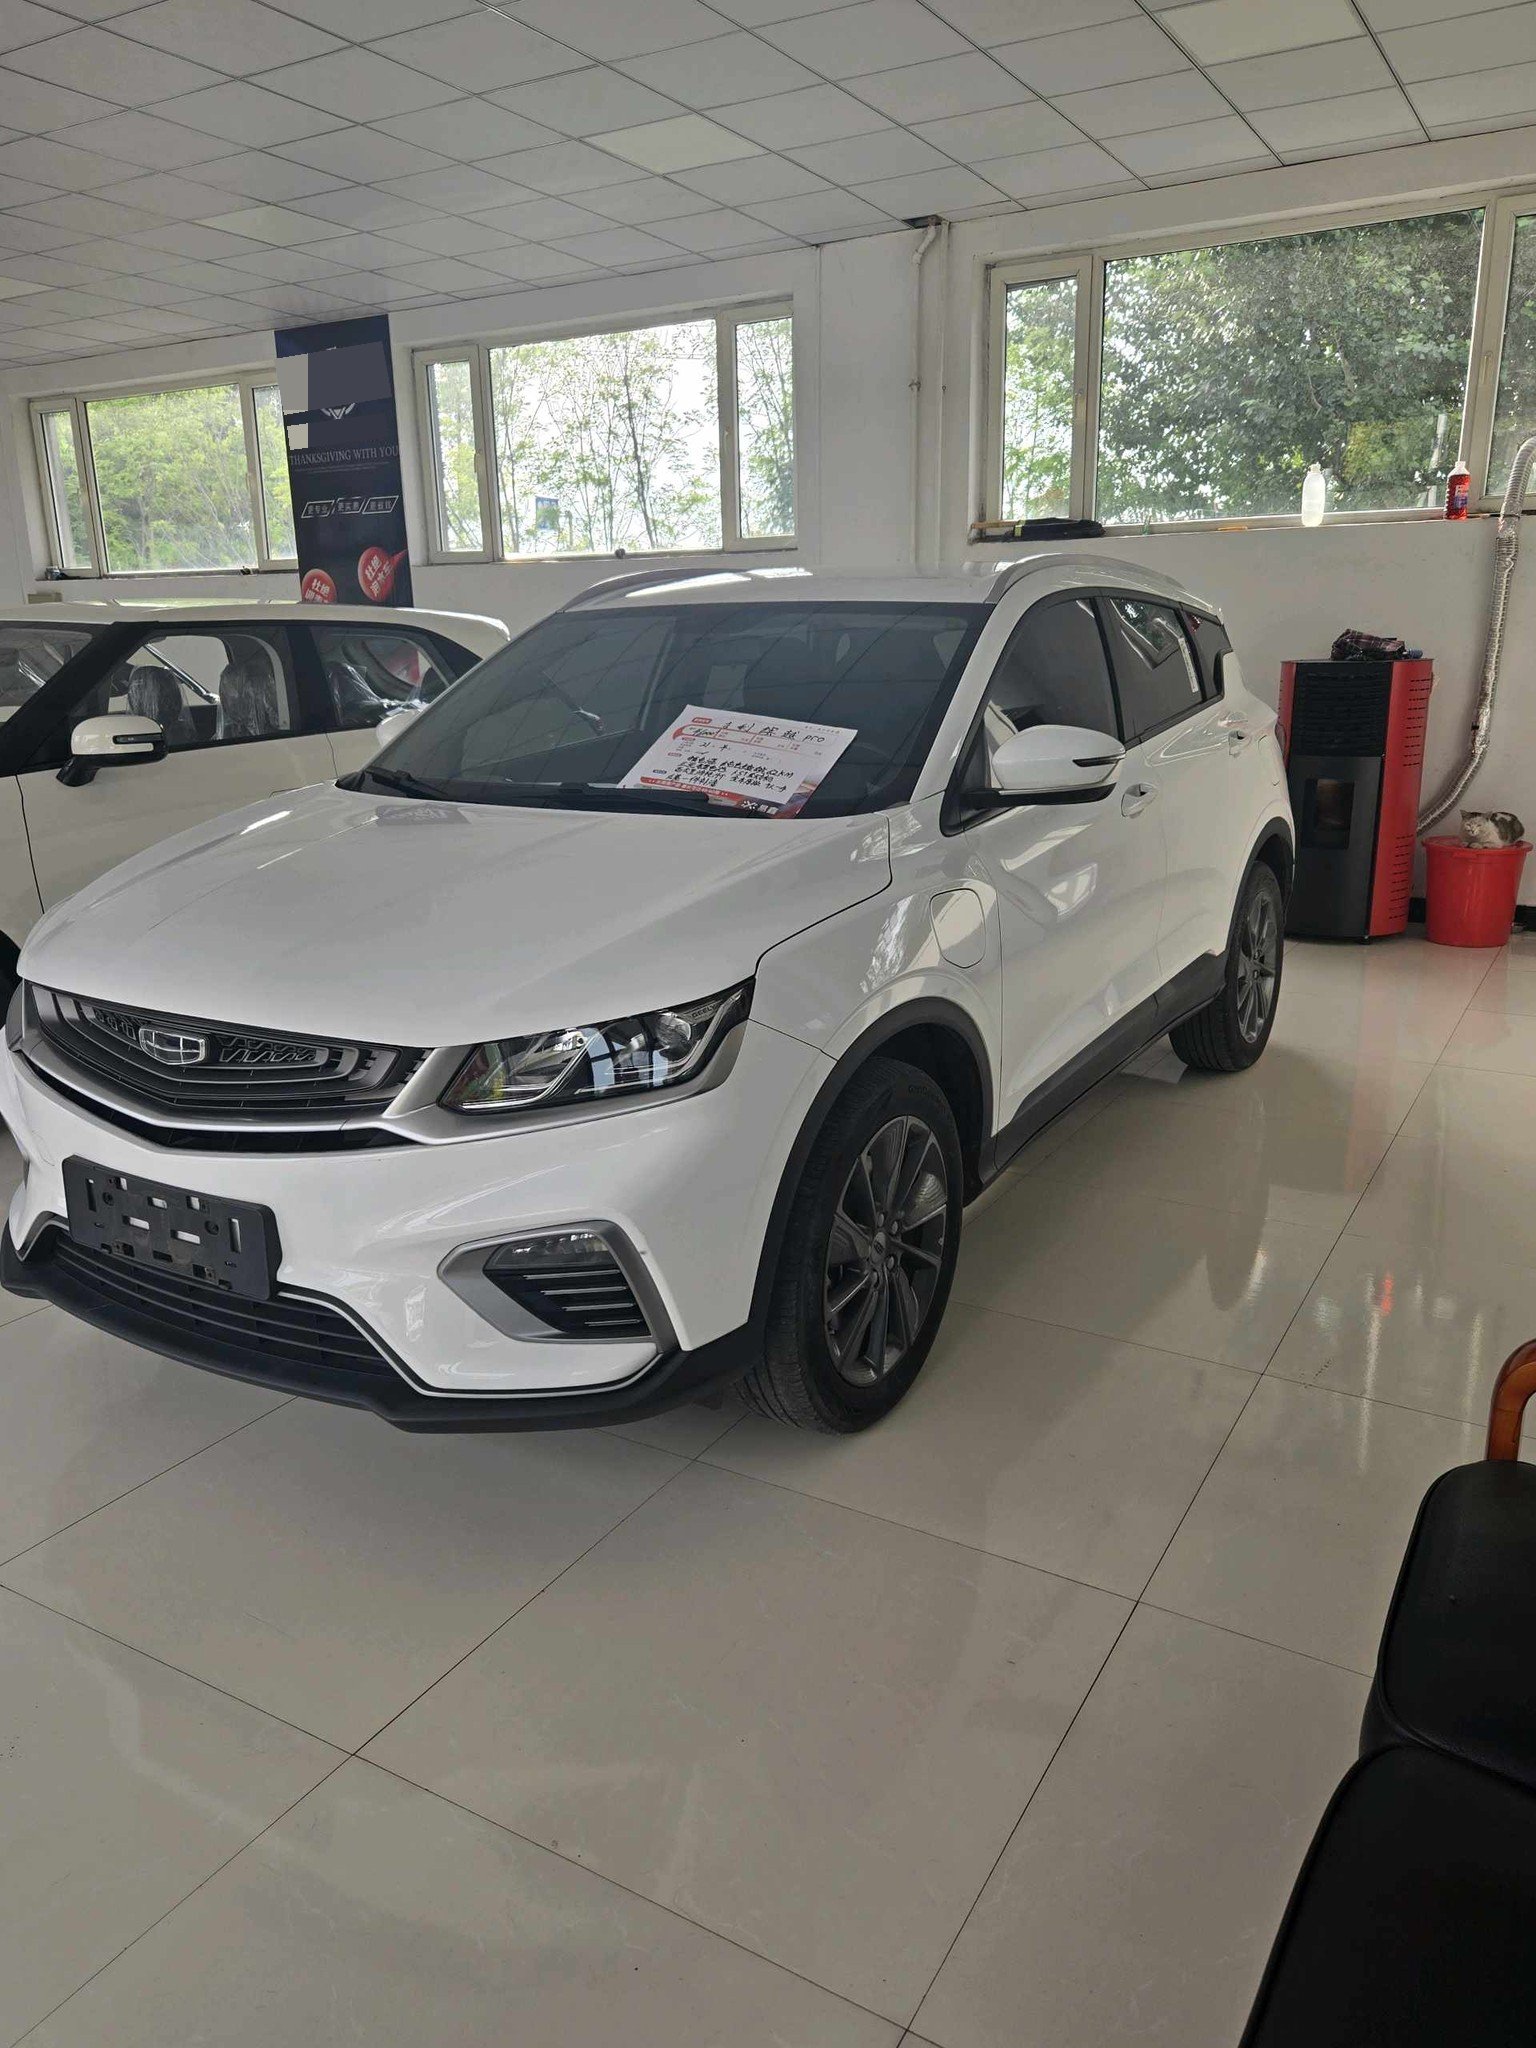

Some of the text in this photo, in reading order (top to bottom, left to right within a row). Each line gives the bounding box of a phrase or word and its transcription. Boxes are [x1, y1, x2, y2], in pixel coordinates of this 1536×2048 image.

[290, 445, 399, 465] THANKSGIVING WITH YOU
[691, 1004, 717, 1018] GEELY
